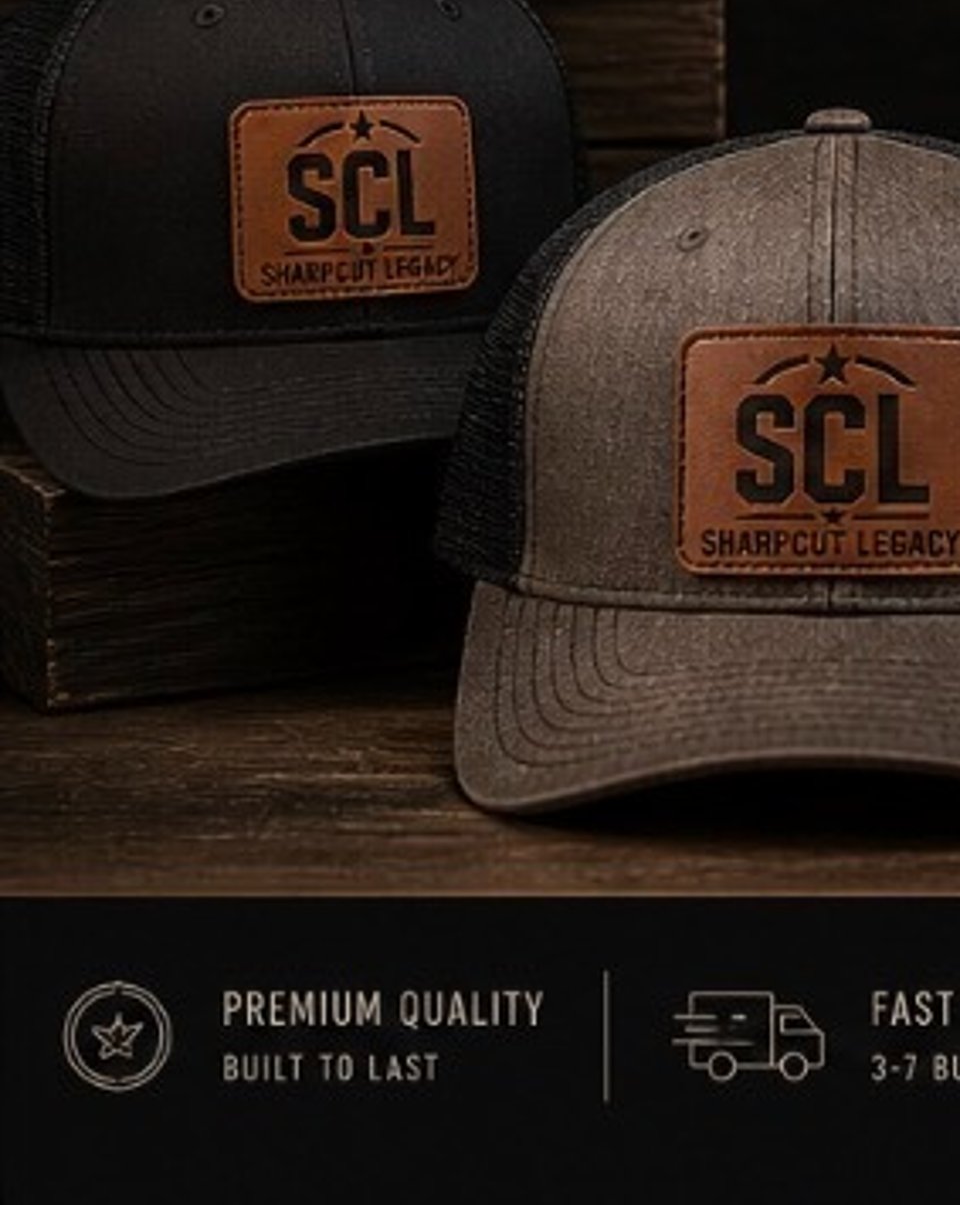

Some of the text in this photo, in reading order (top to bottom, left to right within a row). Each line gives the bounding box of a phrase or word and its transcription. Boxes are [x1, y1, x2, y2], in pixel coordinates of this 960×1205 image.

[287, 149, 436, 242] SCL
[261, 258, 377, 287] SHARPCUT
[735, 394, 930, 504] SCL
[701, 530, 960, 557] SHARPCUT LEGACY
